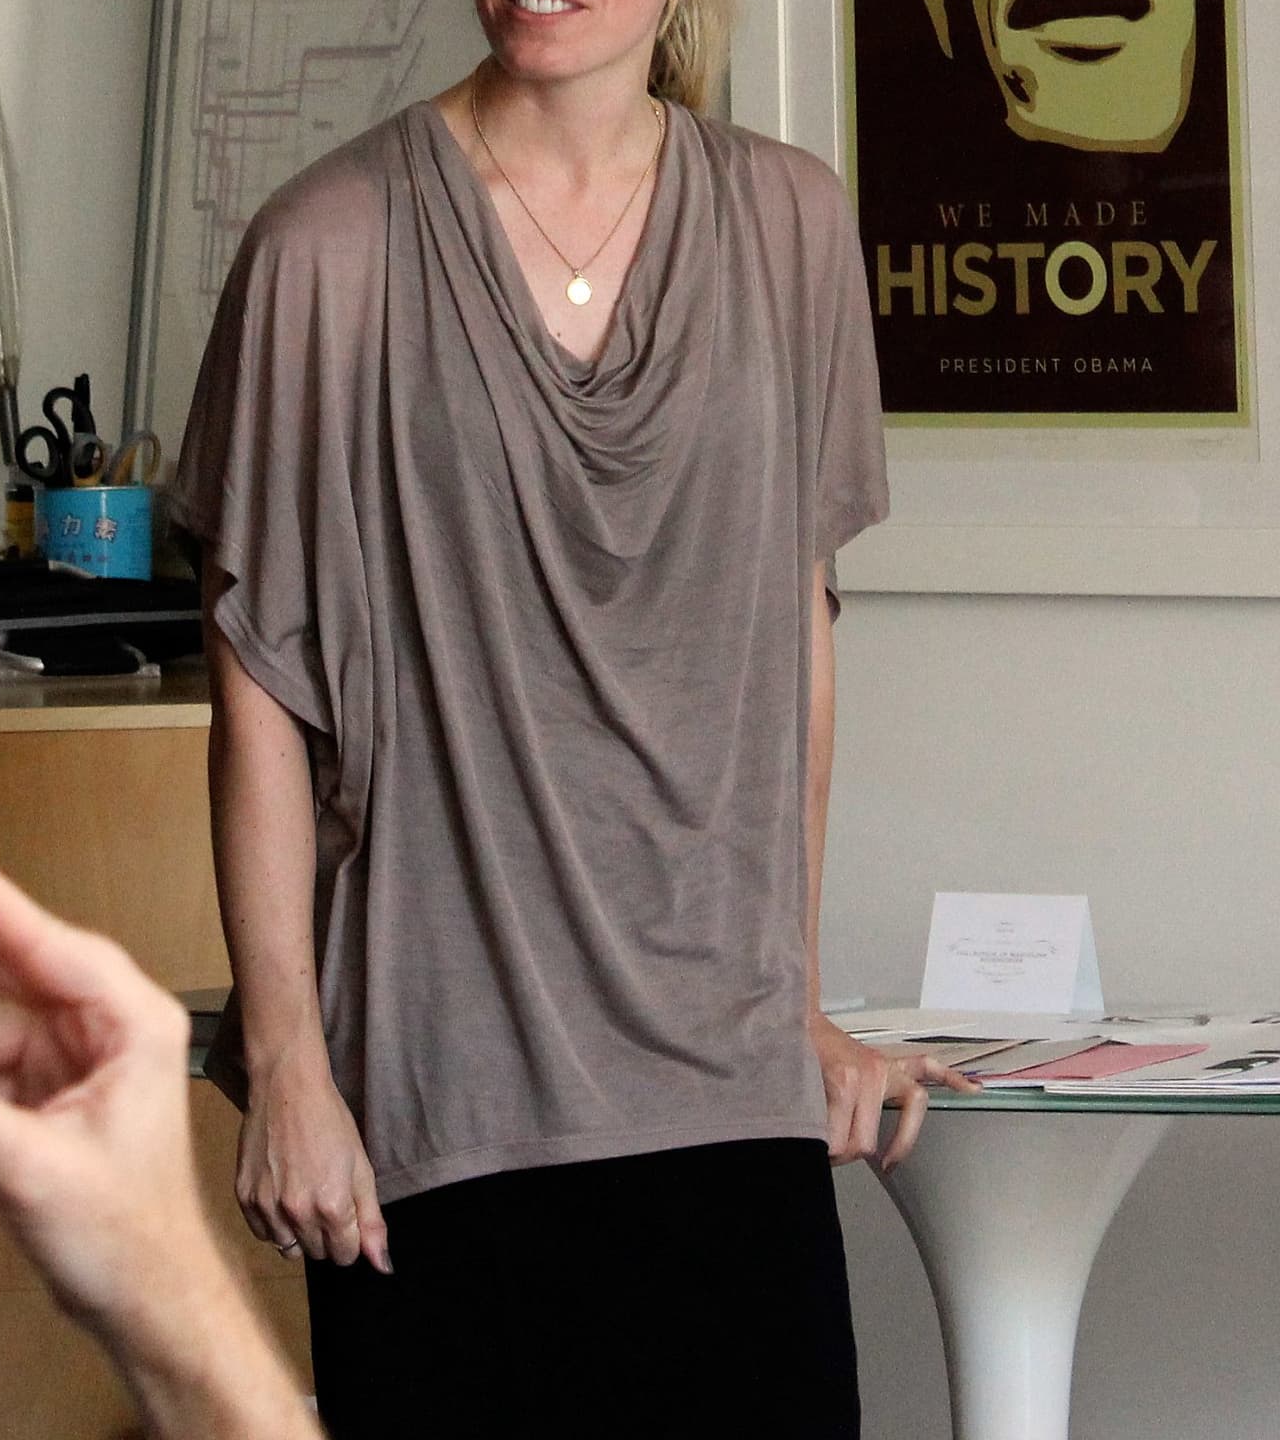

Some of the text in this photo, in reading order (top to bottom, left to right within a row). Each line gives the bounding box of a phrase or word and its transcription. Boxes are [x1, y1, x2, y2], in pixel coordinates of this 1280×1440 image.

[937, 199, 1148, 229] WE MADE
[876, 239, 1219, 317] HISTORY
[939, 356, 1154, 374] PRESIDENT OBAMA
